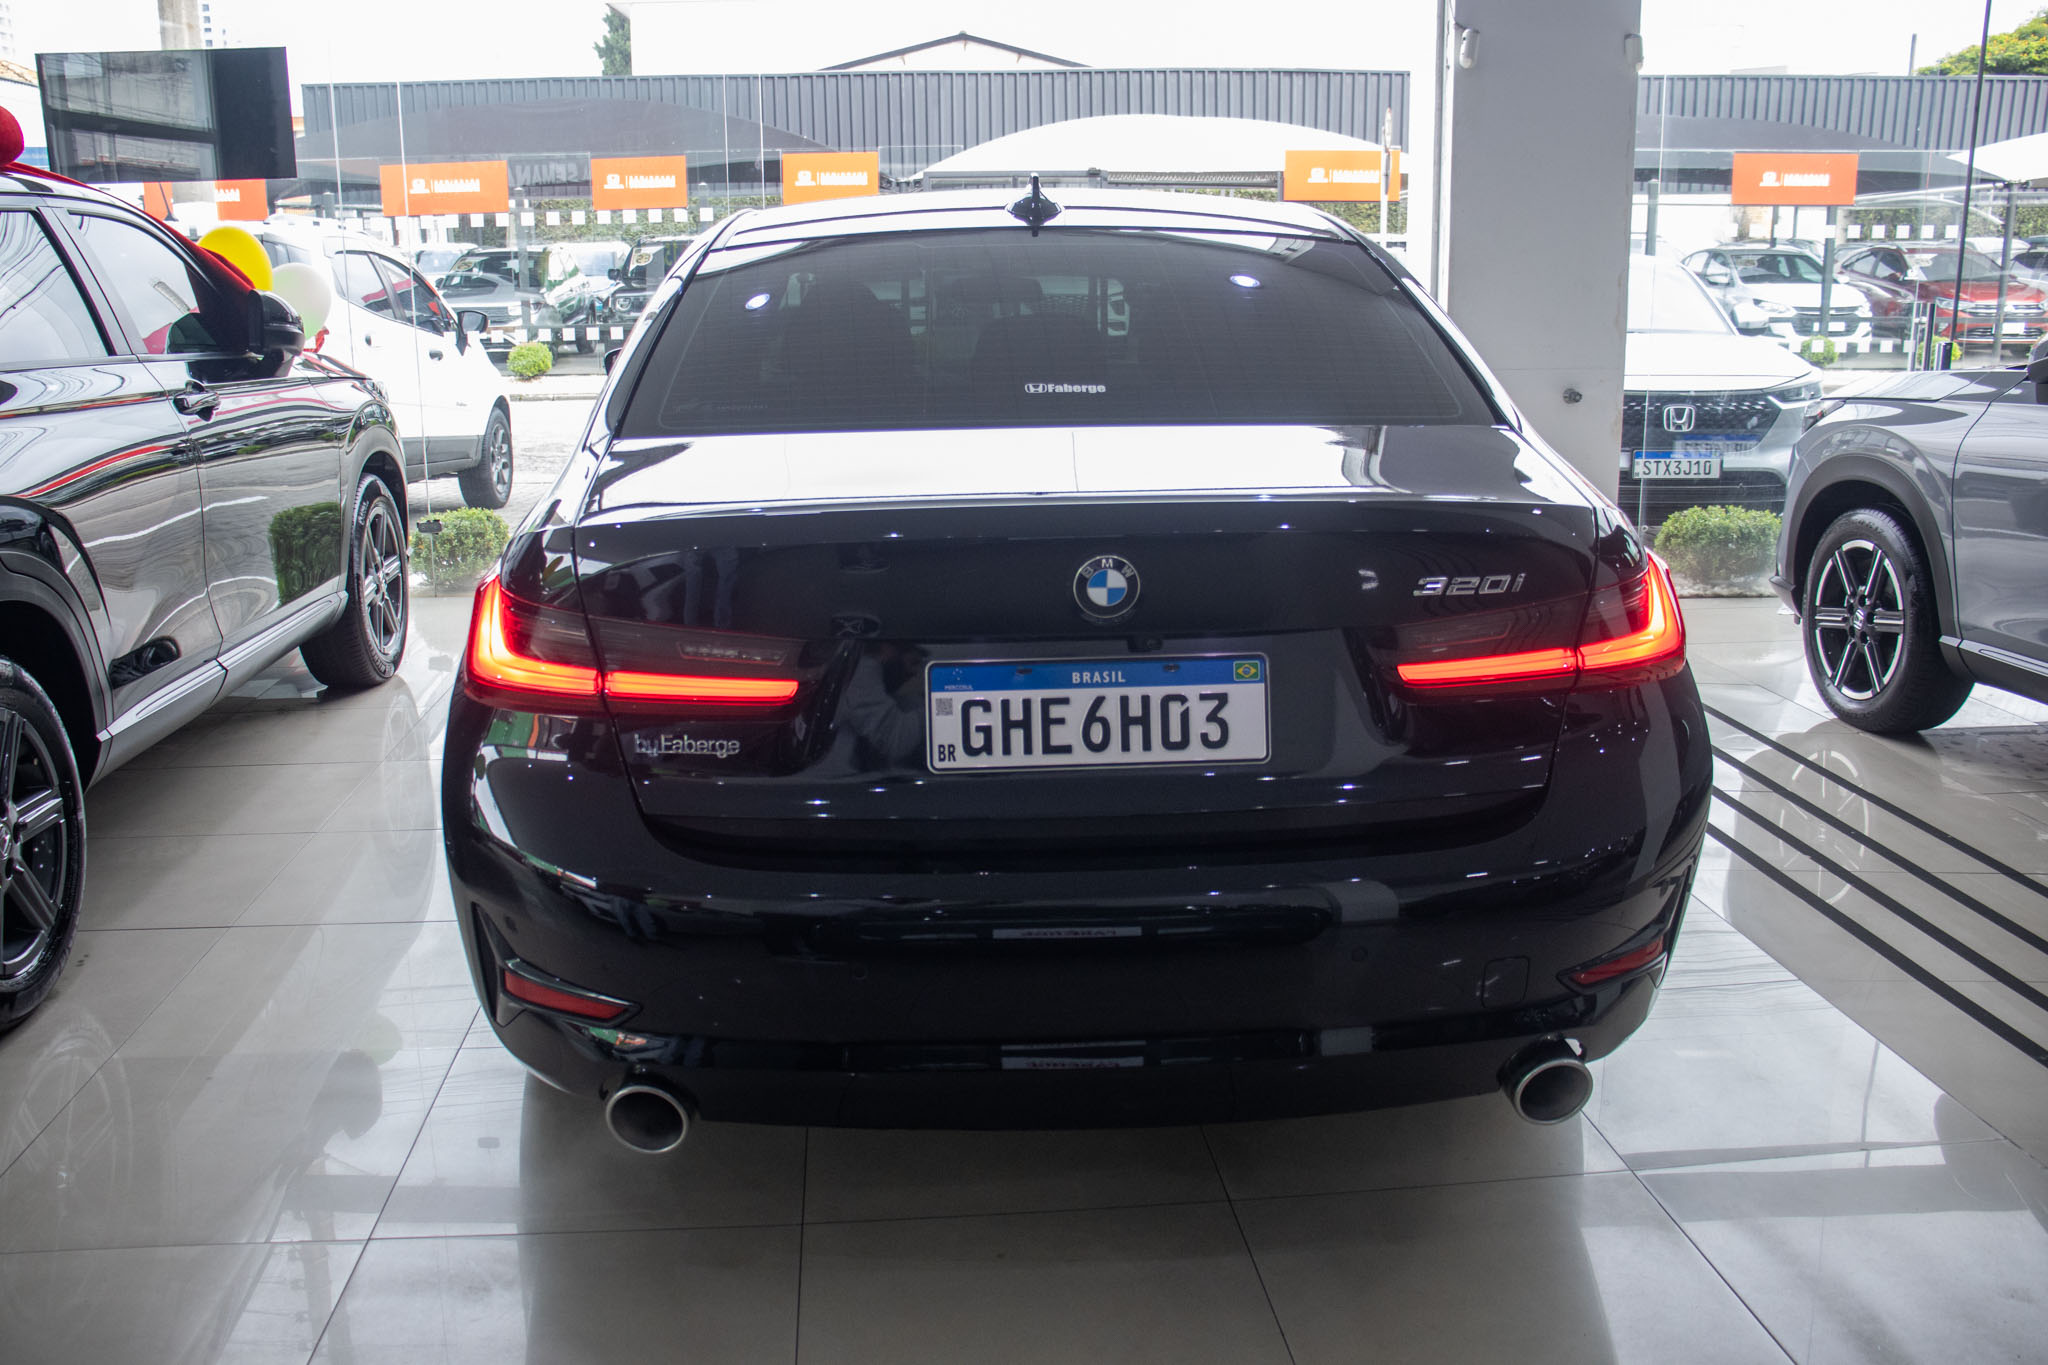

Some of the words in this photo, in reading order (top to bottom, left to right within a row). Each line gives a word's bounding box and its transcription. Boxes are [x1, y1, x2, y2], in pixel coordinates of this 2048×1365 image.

[1642, 460, 1712, 476] STX3J10
[1080, 558, 1135, 579] BMW
[1413, 572, 1527, 597] 320i
[1072, 671, 1126, 685] BRASIL
[960, 692, 1230, 757] GHE6H03
[938, 744, 957, 763] BR
